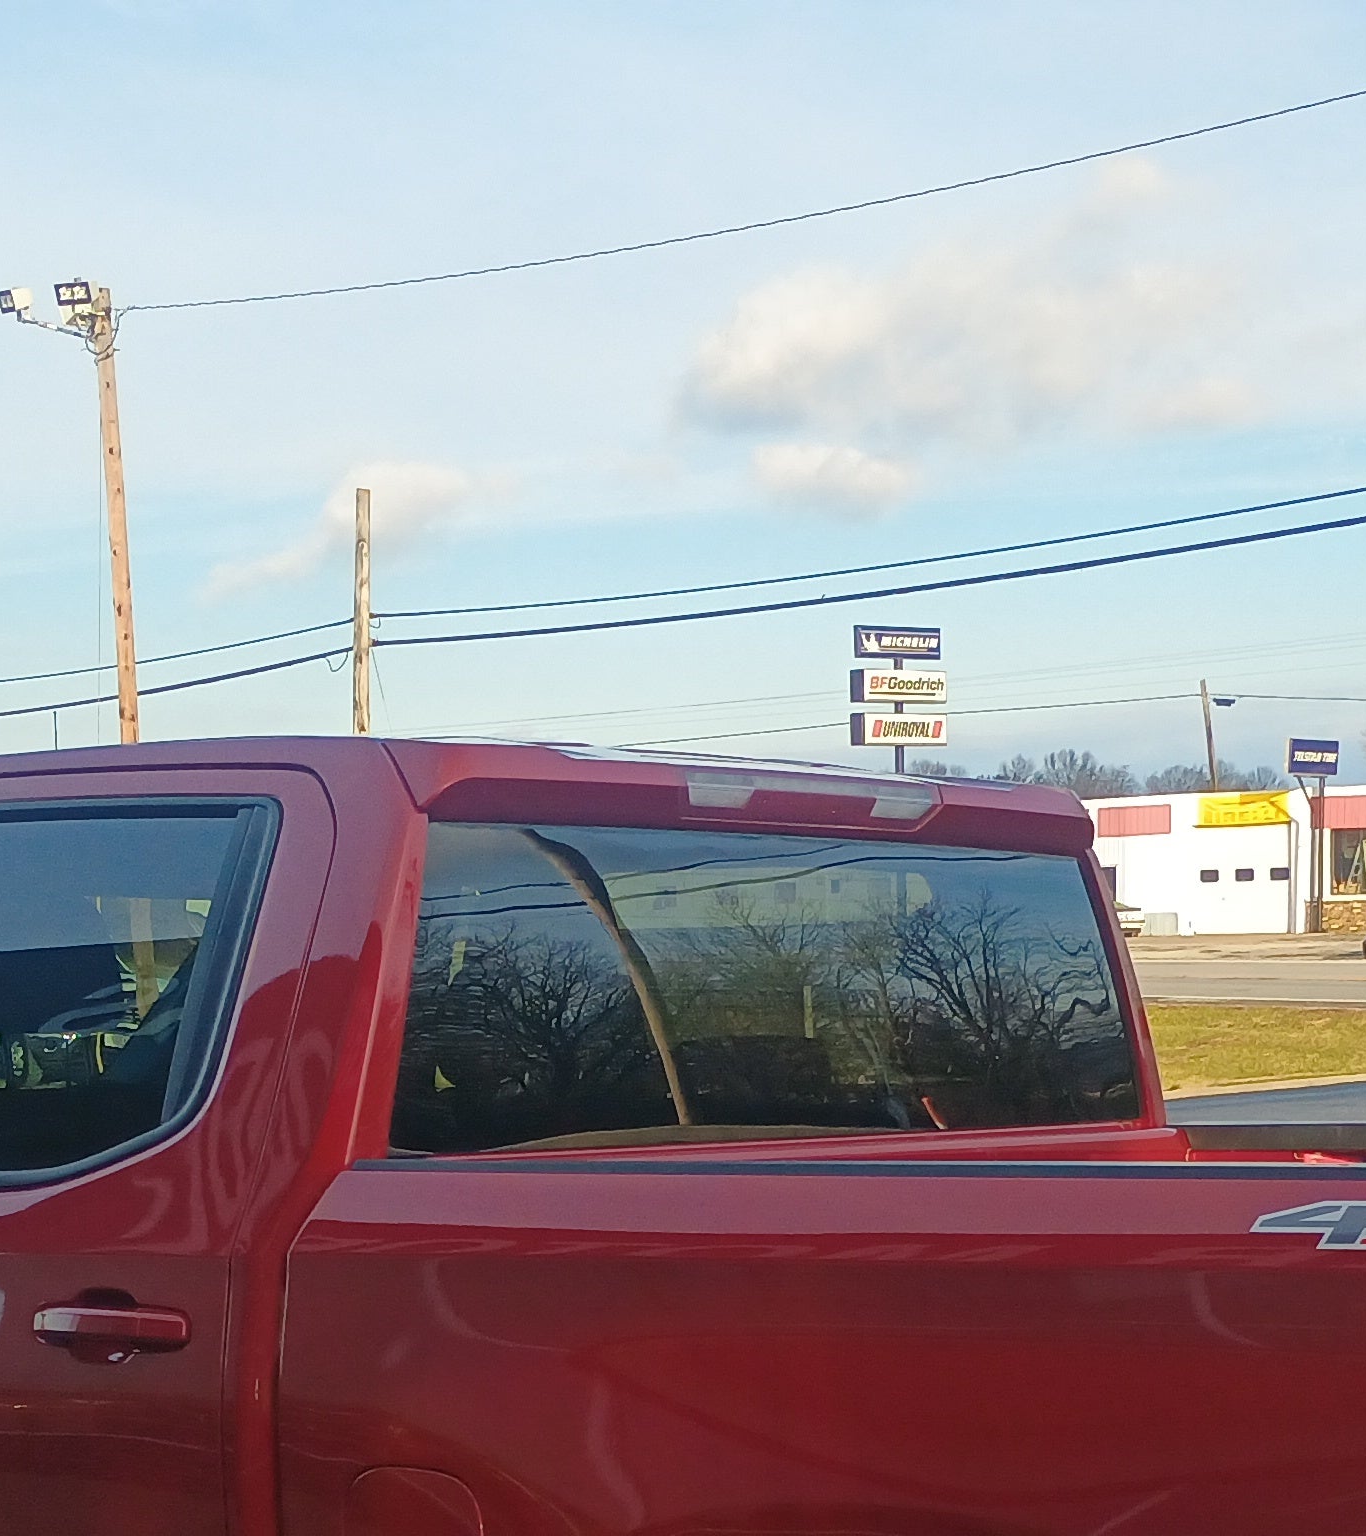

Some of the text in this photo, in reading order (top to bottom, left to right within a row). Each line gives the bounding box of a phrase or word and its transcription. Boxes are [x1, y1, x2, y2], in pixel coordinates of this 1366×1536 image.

[880, 636, 938, 648] MICHELIN
[870, 676, 944, 691] BFGoodrich
[882, 721, 930, 738] UNIROYAL
